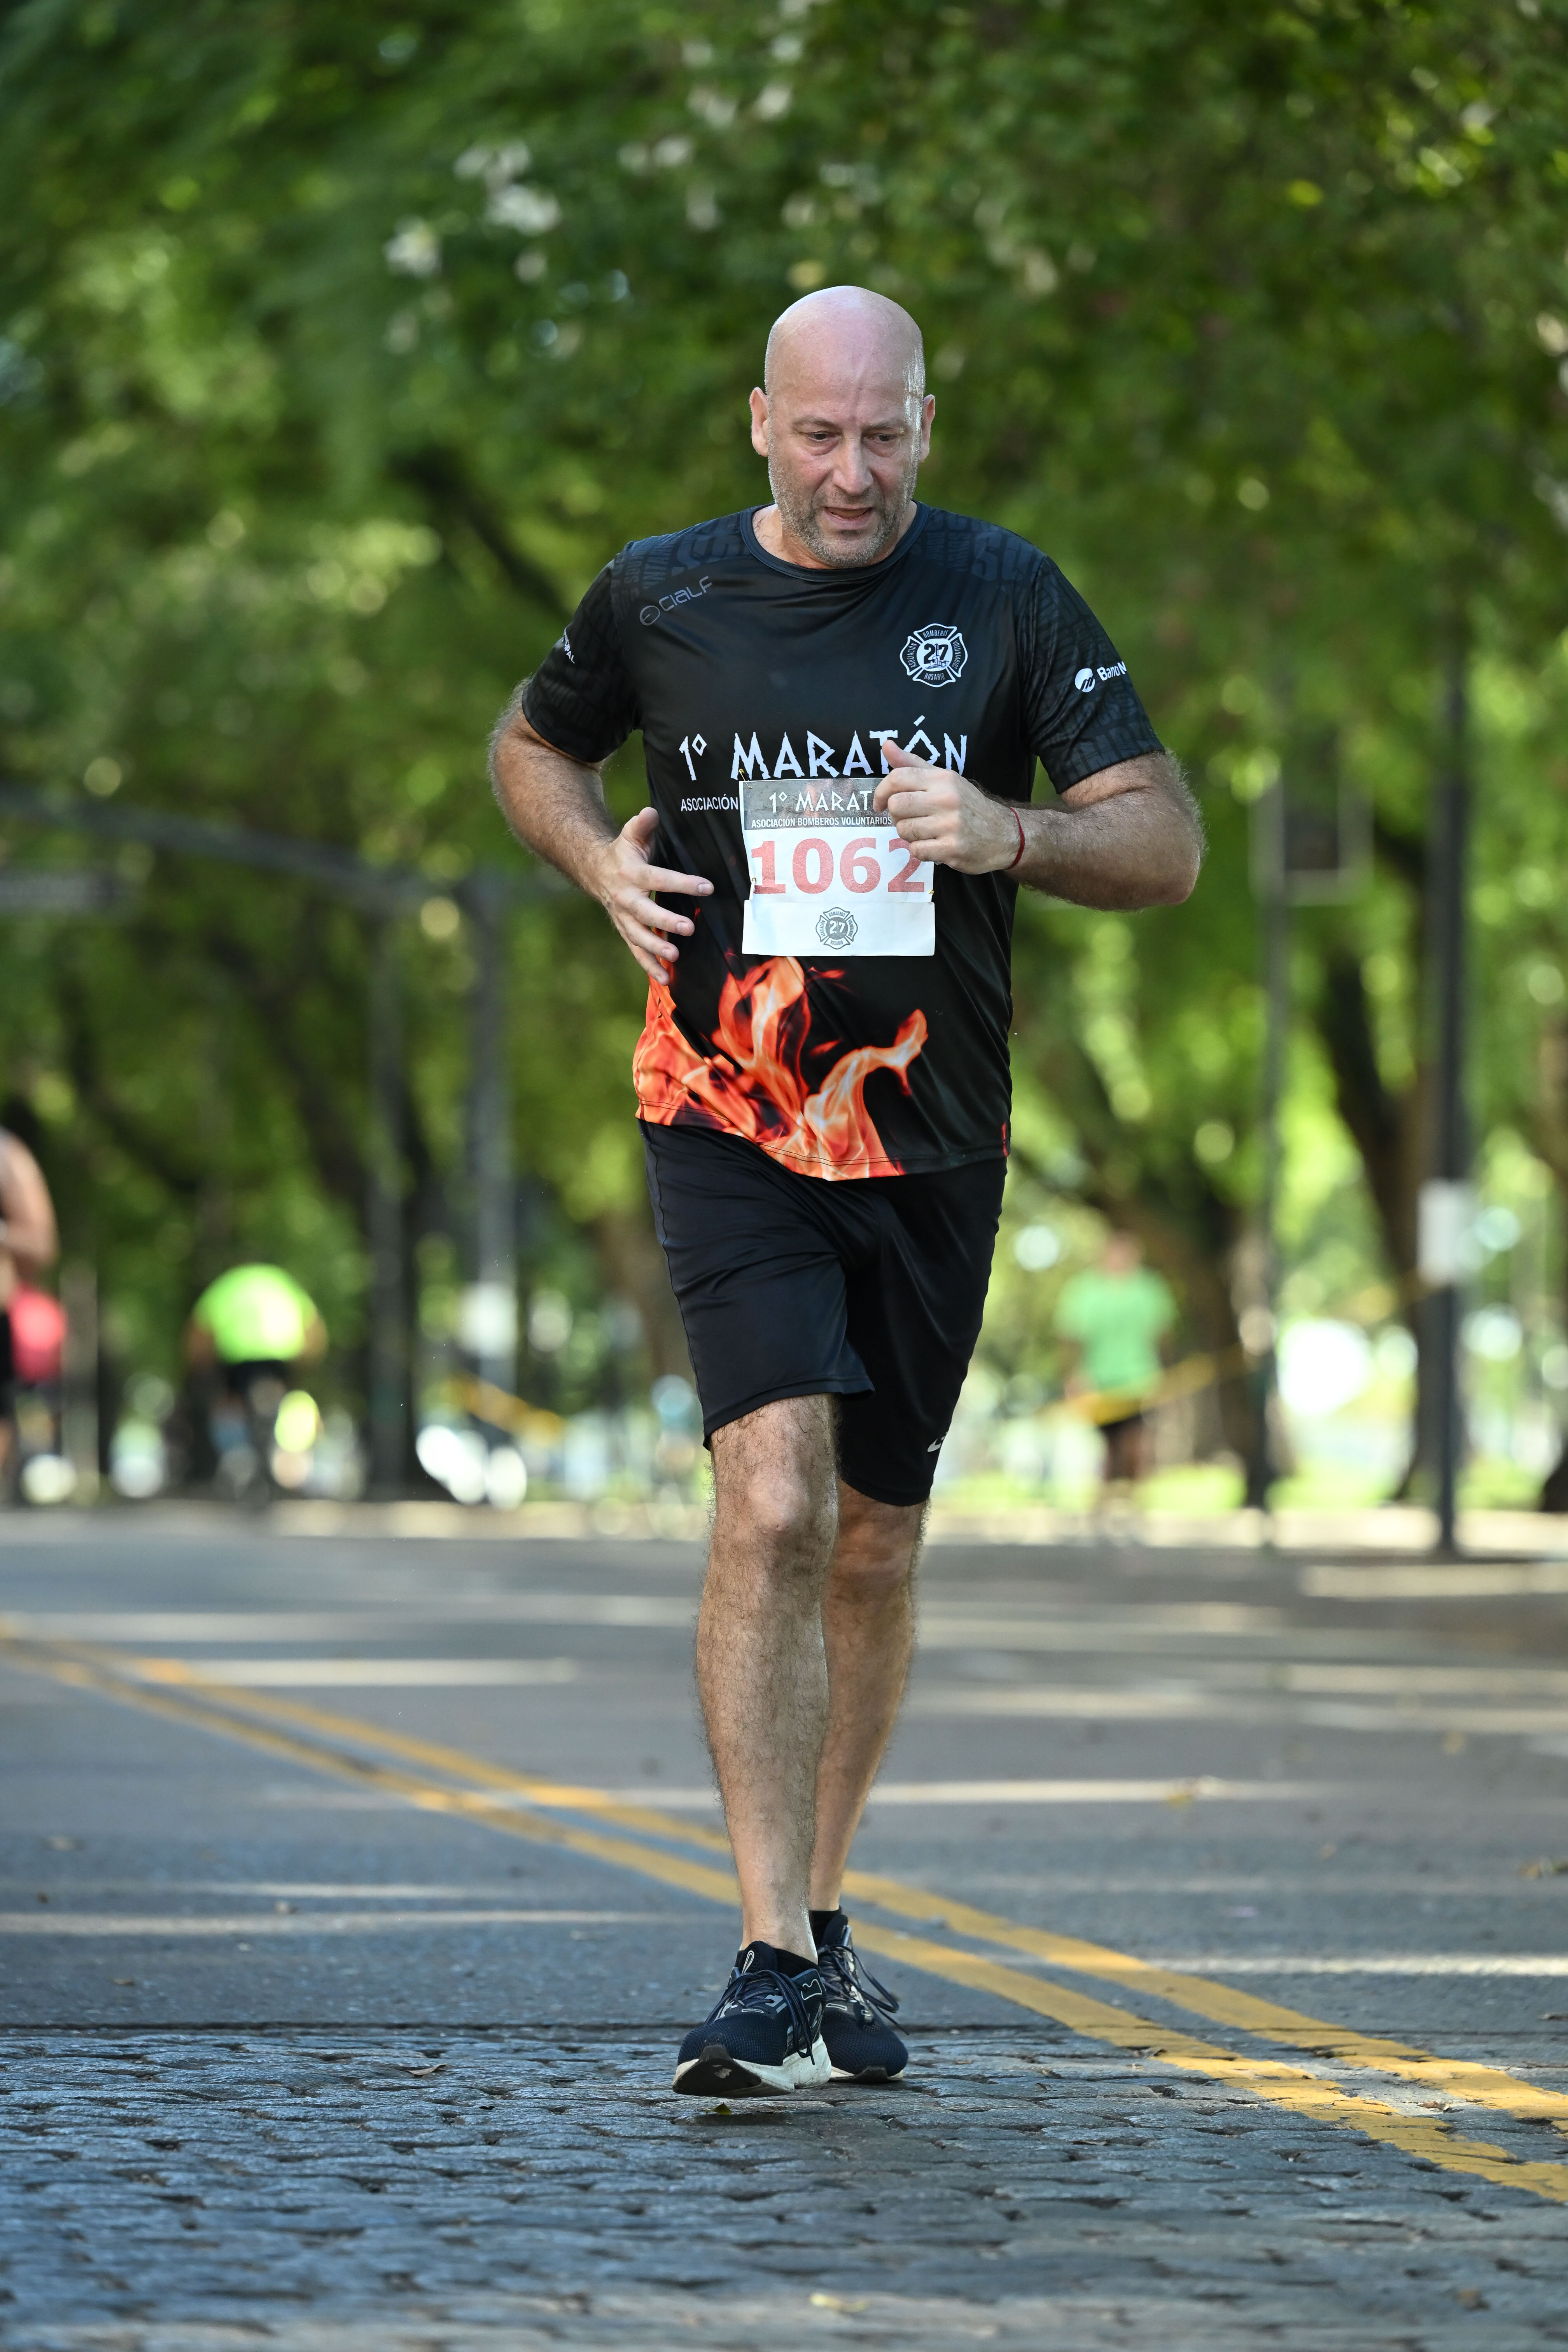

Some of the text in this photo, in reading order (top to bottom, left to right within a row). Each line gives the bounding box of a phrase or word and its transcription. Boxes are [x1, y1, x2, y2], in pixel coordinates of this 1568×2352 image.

[922, 630, 949, 638] BOMBEROS
[907, 642, 918, 668] ASOCIACIÓN
[923, 643, 949, 664] 27
[952, 640, 961, 669] VOLUNTARIOS
[731, 714, 968, 780] MARATÓN
[681, 793, 738, 812] ASOCIACIÓN
[795, 791, 873, 812] MARAT
[751, 816, 892, 828] ASOCIACIÓN BOMBEROS VOLUNTARIOS
[751, 838, 925, 894] 1062
[830, 920, 845, 934] 27
